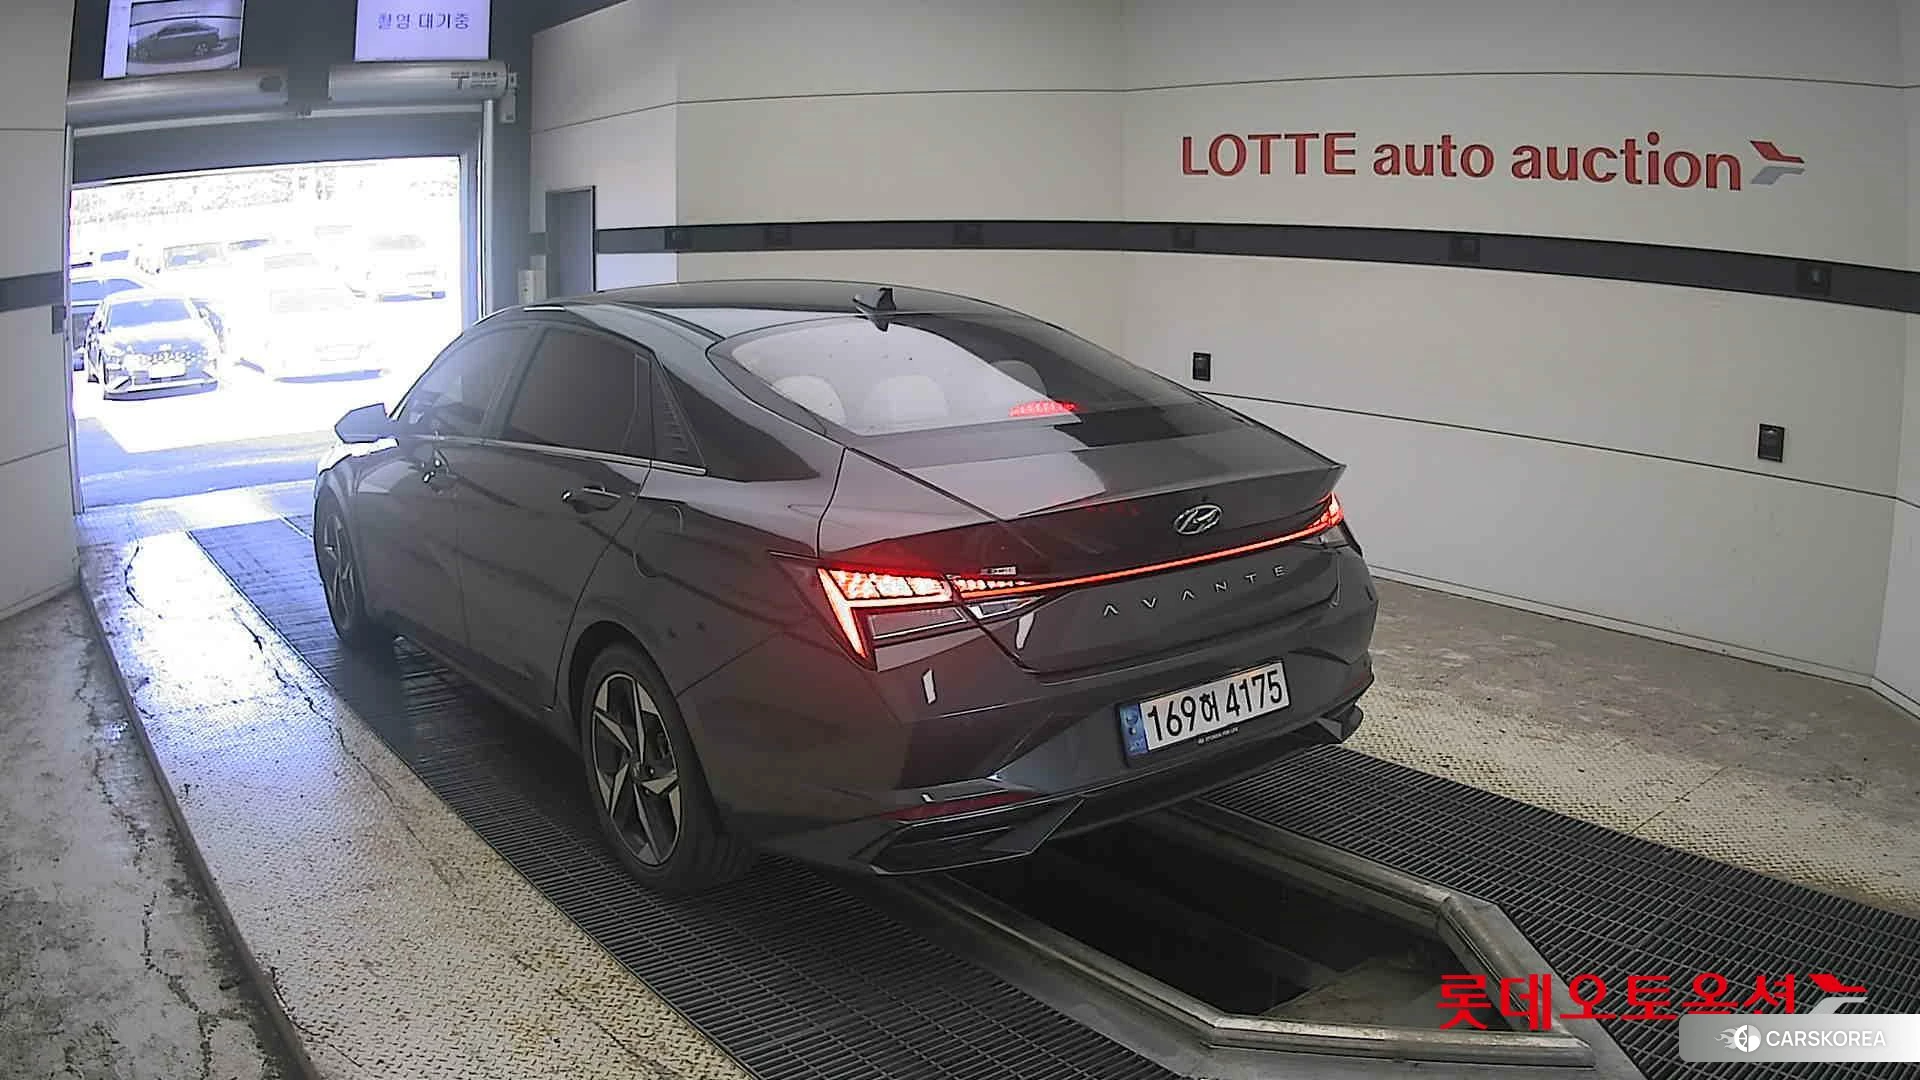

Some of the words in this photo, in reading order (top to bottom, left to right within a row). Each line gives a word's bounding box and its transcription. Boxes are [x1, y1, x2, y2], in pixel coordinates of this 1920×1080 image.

[418, 13, 469, 30] 대기중
[1182, 132, 1356, 177] LOTTE
[1373, 134, 1494, 178] auto
[1511, 131, 1741, 191] auction
[1103, 565, 1288, 617] AVANTE
[1147, 691, 1220, 741] 169허
[1226, 669, 1282, 716] 4175
